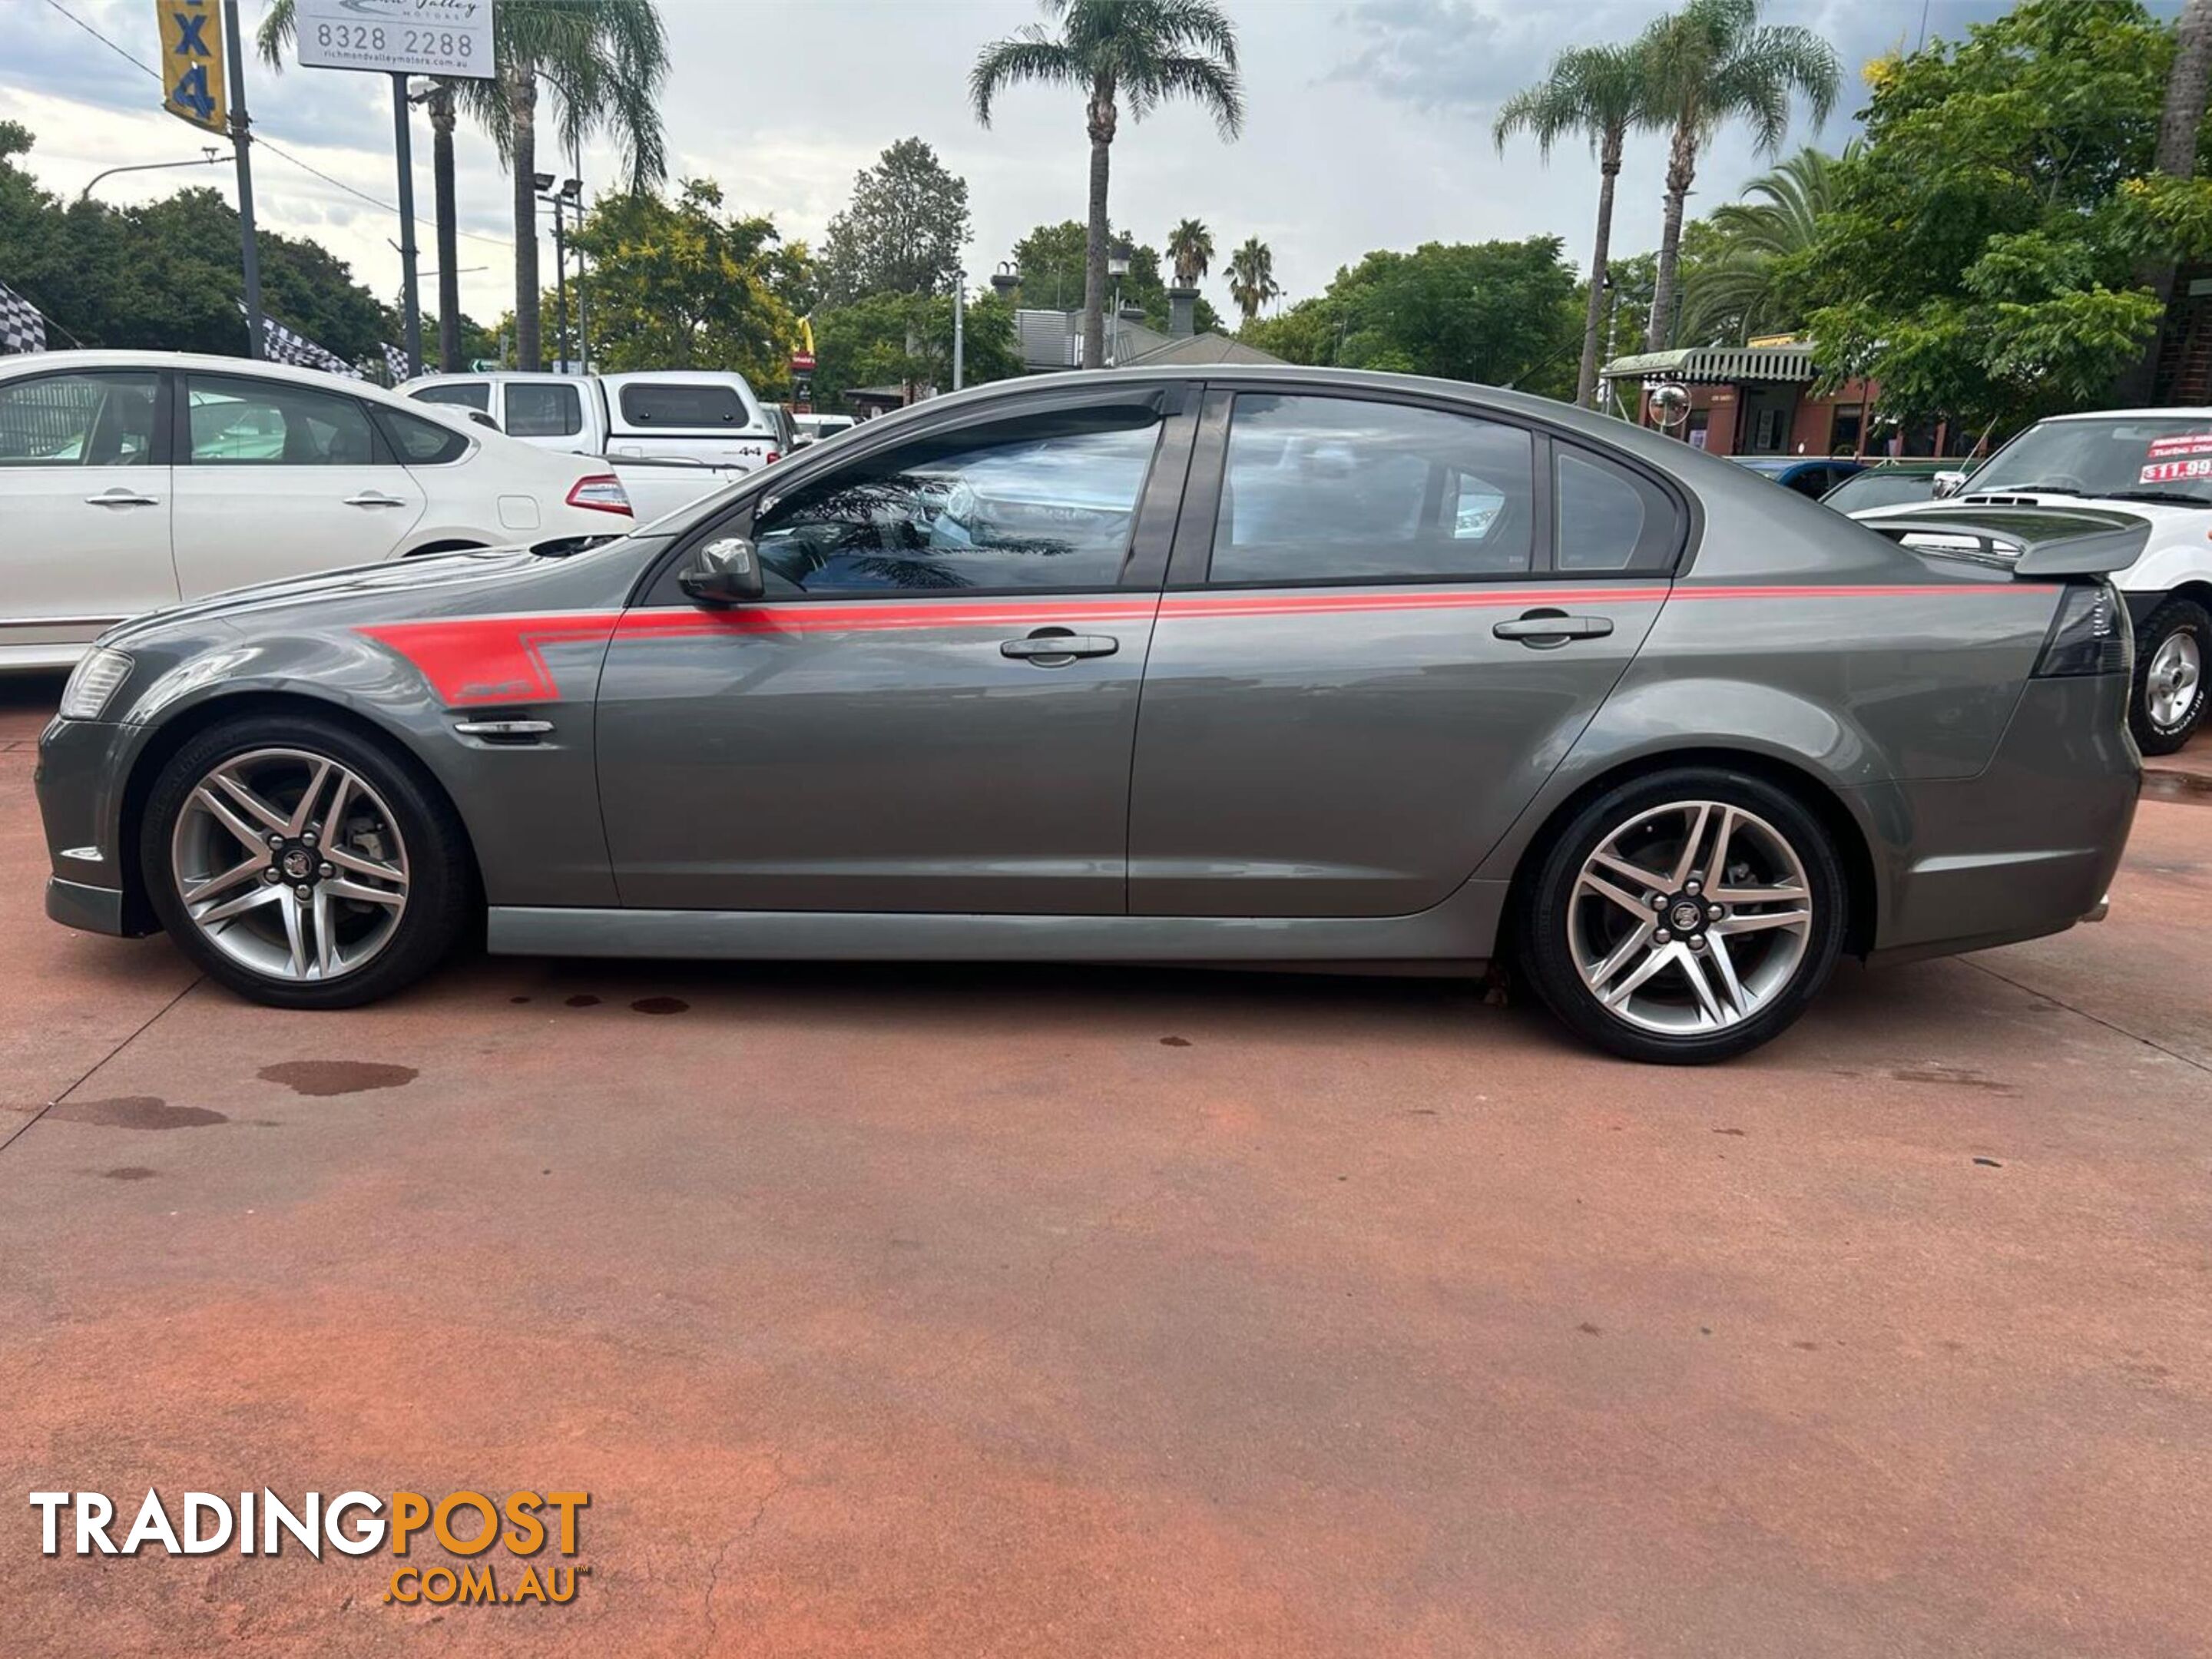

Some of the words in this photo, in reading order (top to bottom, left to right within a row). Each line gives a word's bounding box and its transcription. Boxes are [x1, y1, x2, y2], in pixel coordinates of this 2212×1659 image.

[318, 24, 385, 51] 8328
[405, 30, 472, 58] 2288
[323, 50, 468, 68] richmondvalleymotors.com.au
